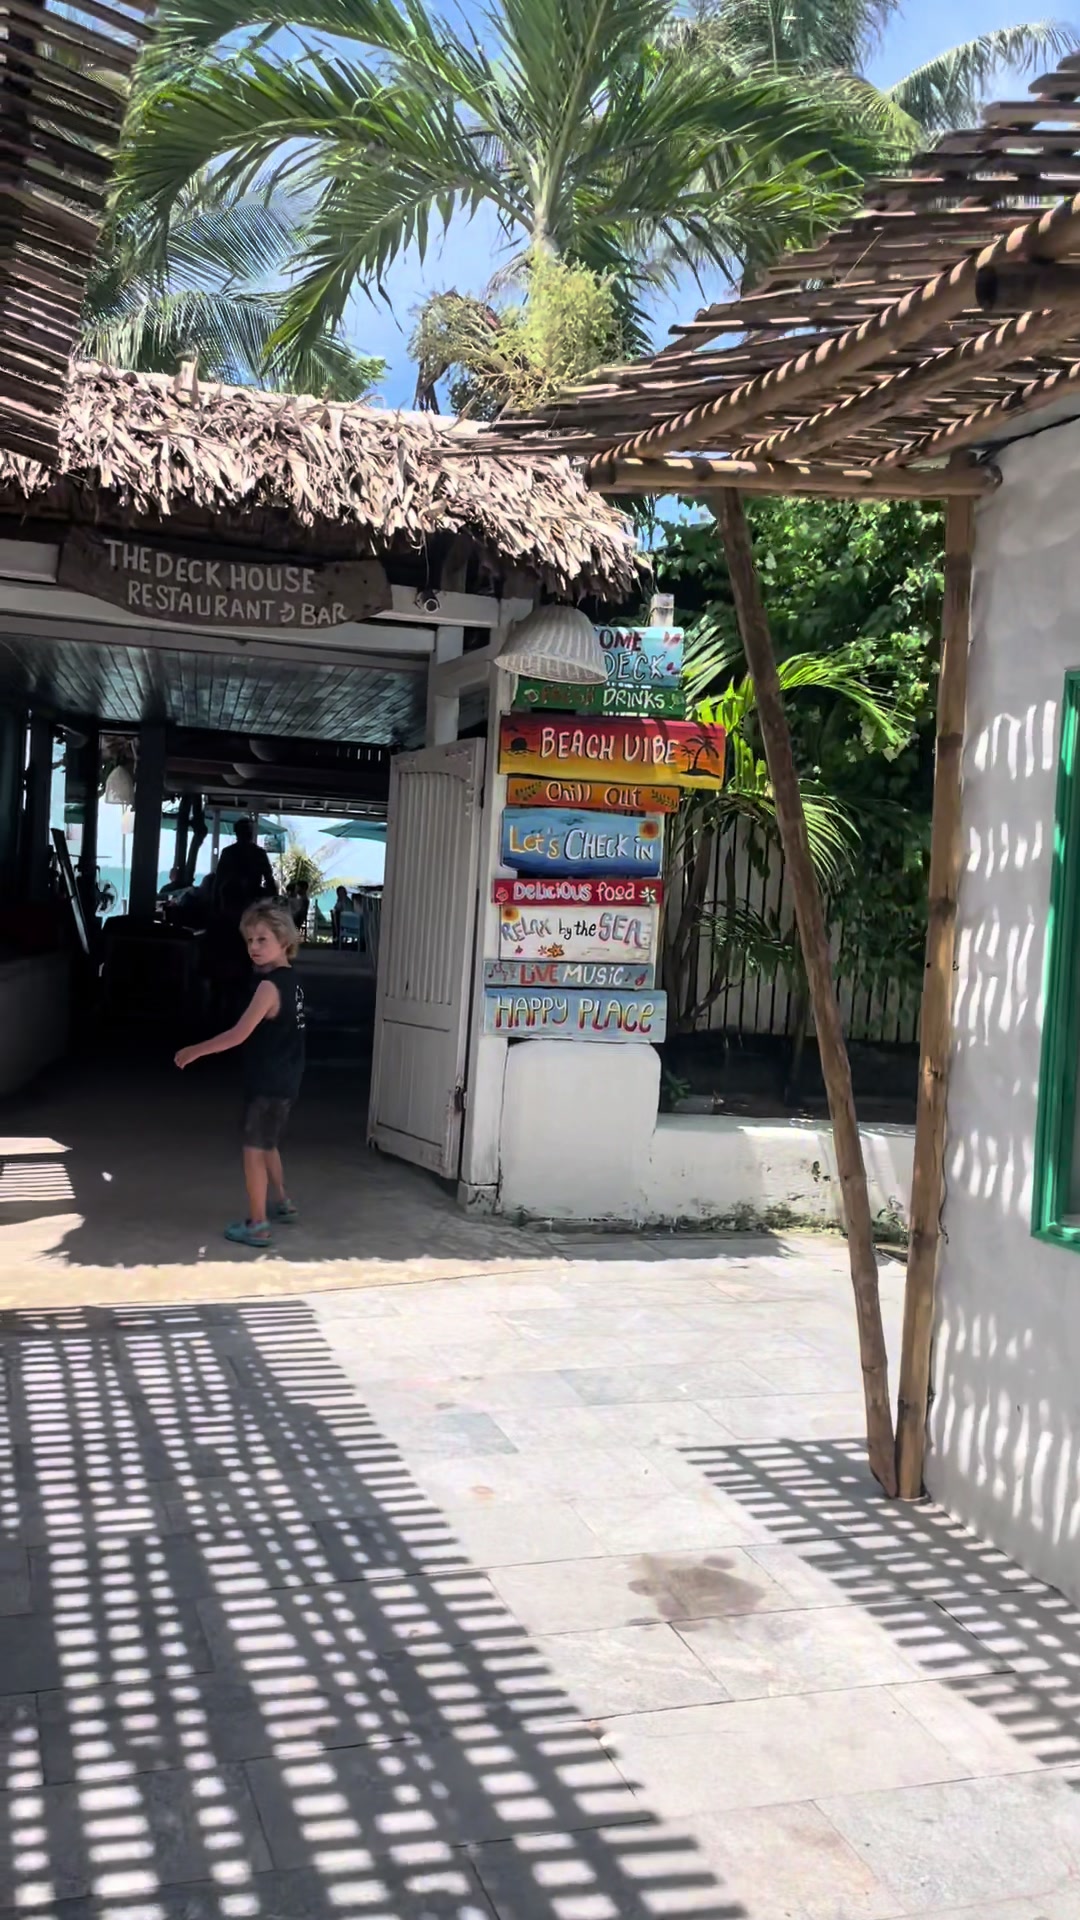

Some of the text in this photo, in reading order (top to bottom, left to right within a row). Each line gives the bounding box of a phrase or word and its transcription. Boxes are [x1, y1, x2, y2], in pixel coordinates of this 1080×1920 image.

[103, 539, 316, 595] THE DECK HOUSE
[128, 580, 276, 621] RESTAURANT
[300, 603, 347, 626] BAR
[602, 687, 666, 709] DRINKS
[540, 726, 680, 764] BEACH VIBE
[564, 828, 629, 861] CHECK
[558, 918, 573, 940] by
[575, 920, 597, 937] the
[598, 912, 649, 948] SEA
[495, 996, 569, 1029] HAPPY
